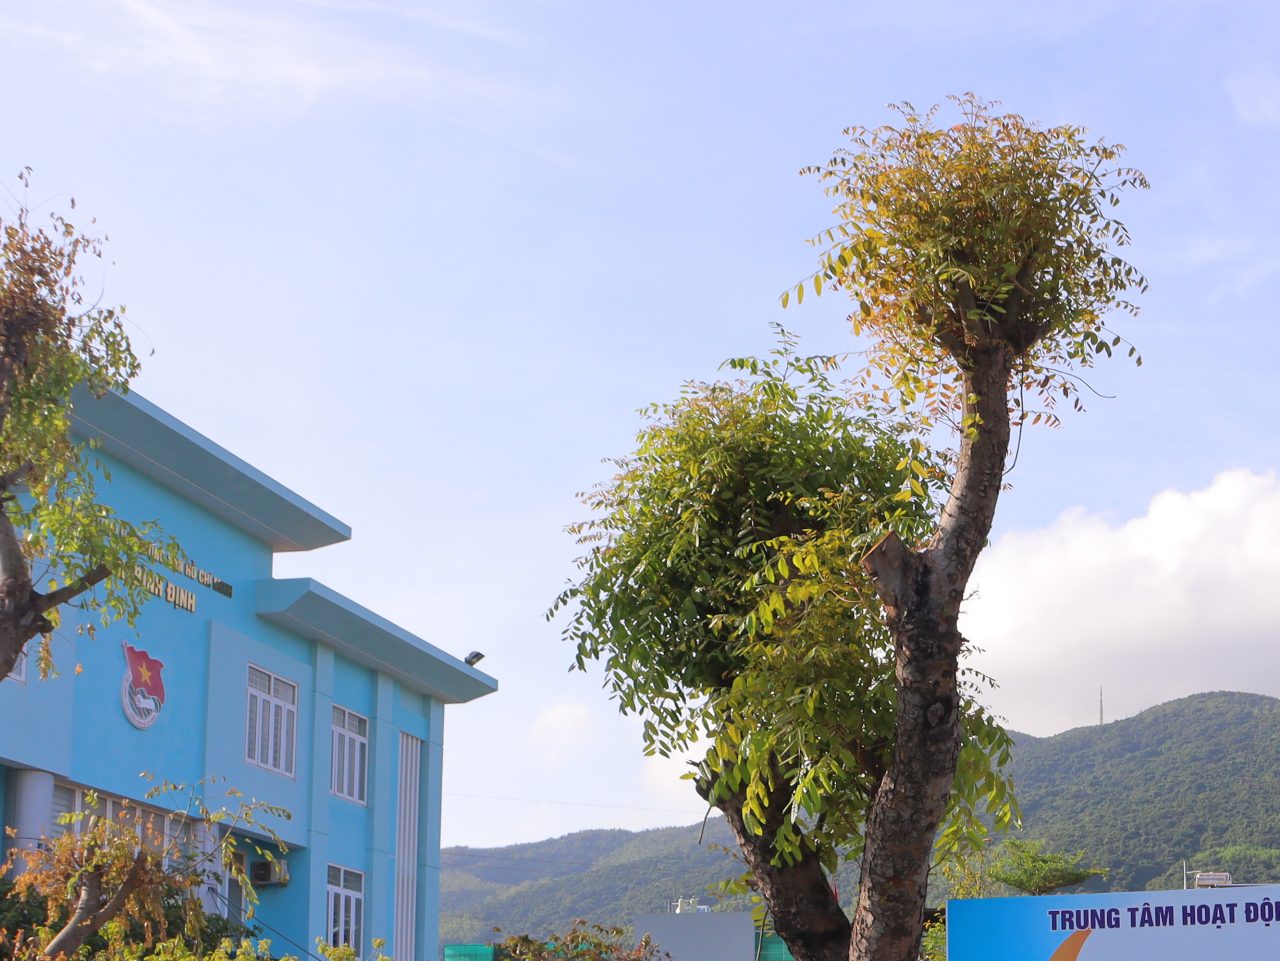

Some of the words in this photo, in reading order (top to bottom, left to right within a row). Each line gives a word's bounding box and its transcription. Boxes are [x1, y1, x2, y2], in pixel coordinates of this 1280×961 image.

[166, 581, 195, 613] ĐỊNH
[1048, 908, 1120, 931] TRUNG
[1127, 902, 1174, 927] TÂM
[1182, 902, 1238, 929] HOẠT
